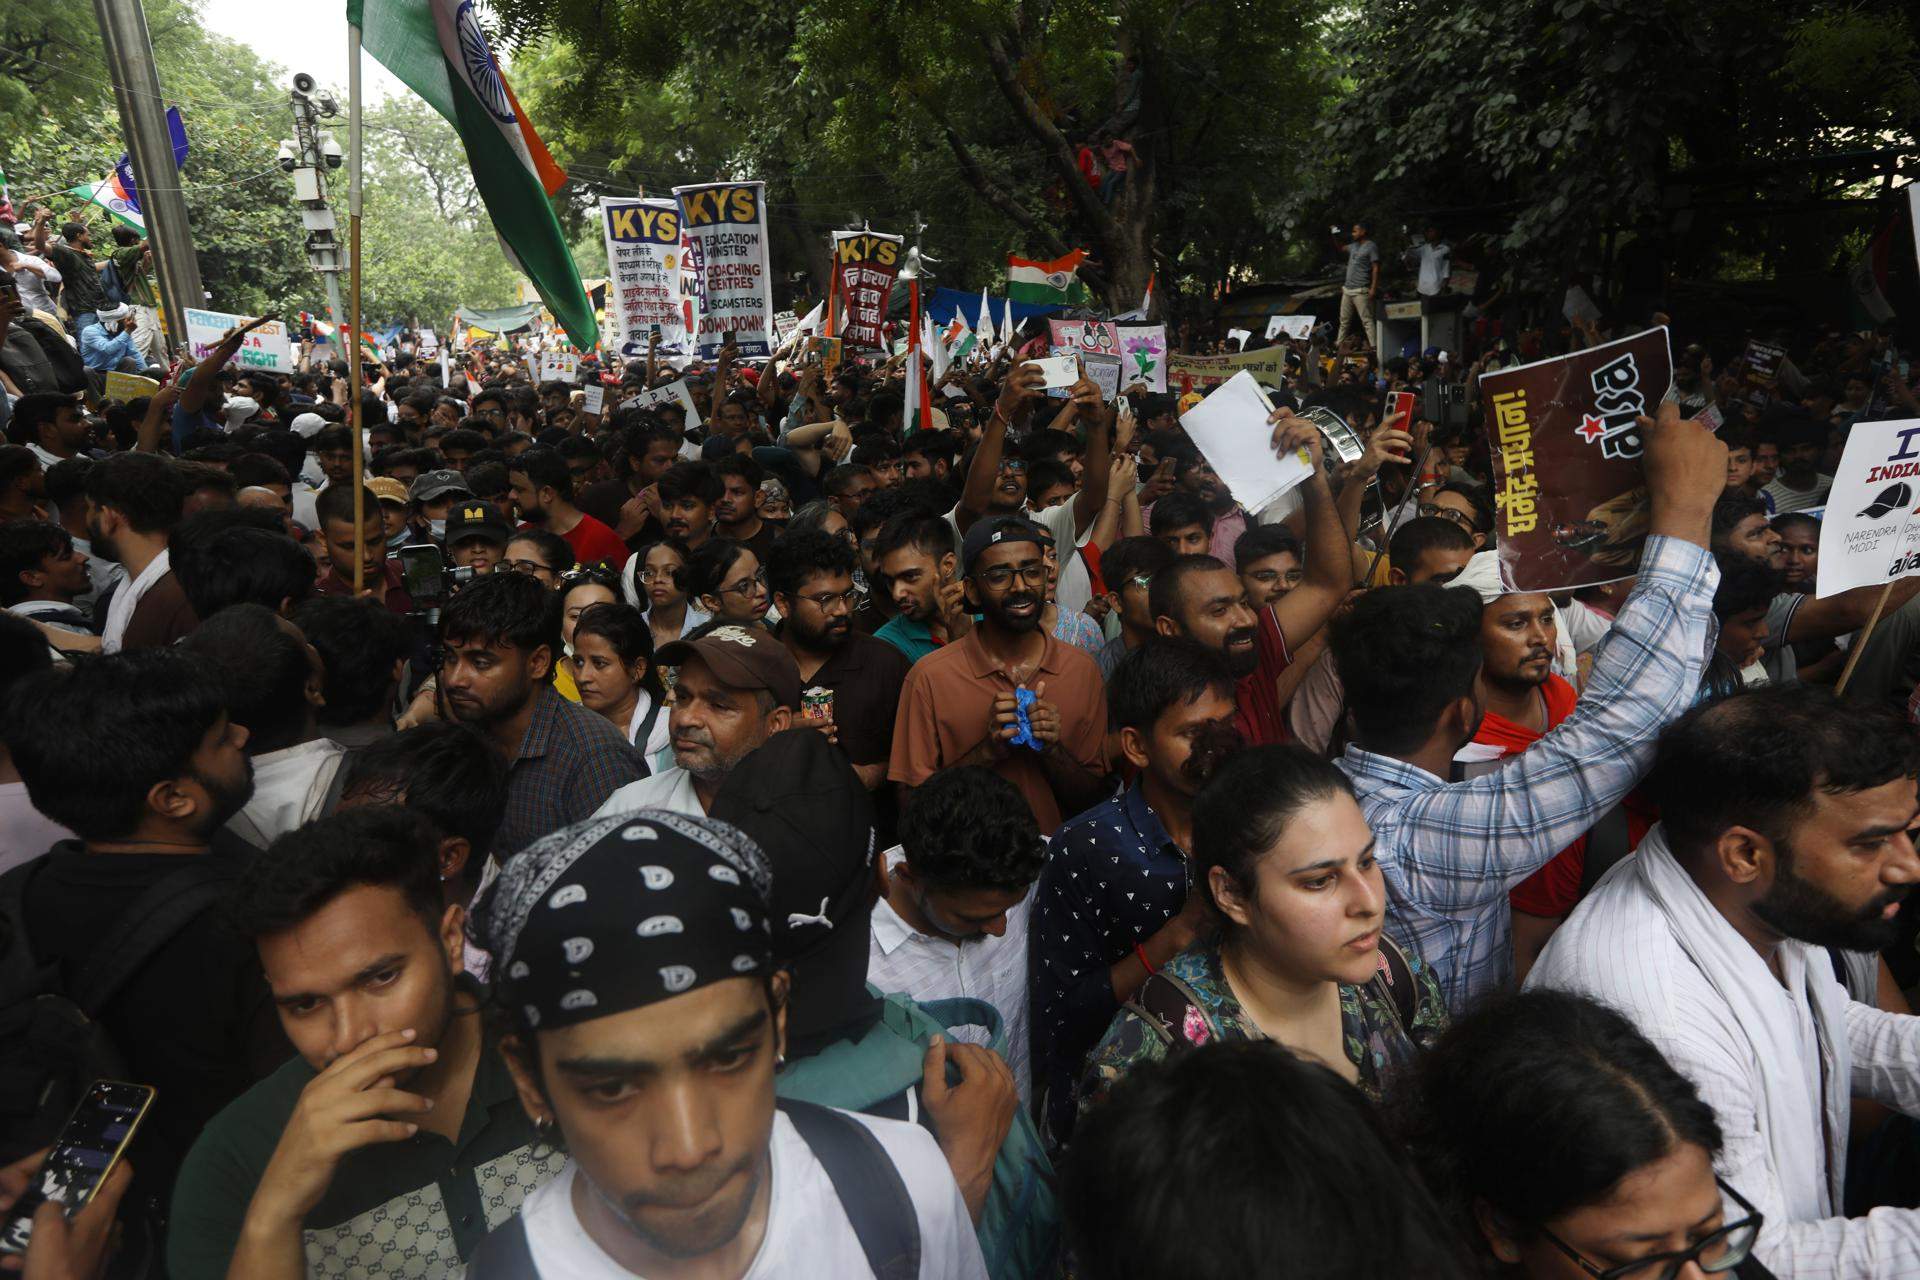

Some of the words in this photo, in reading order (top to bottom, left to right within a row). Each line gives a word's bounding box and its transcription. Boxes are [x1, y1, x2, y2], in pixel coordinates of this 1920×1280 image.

[680, 188, 754, 225] KYS
[612, 208, 677, 241] KYS
[839, 236, 898, 266] KYS
[619, 272, 638, 283] बेचना
[706, 264, 761, 278] COACHING
[662, 285, 670, 297] के
[707, 277, 754, 291] CENTRES
[711, 297, 763, 310] SCAMSTERS
[731, 315, 765, 332] DOWN!
[253, 337, 262, 347] A
[242, 348, 278, 368] RIGHT
[1583, 352, 1645, 460] aisa
[1492, 388, 1535, 474] प्रधान!
[1844, 525, 1897, 545] NARENDRA
[1848, 540, 1880, 555] MODI
